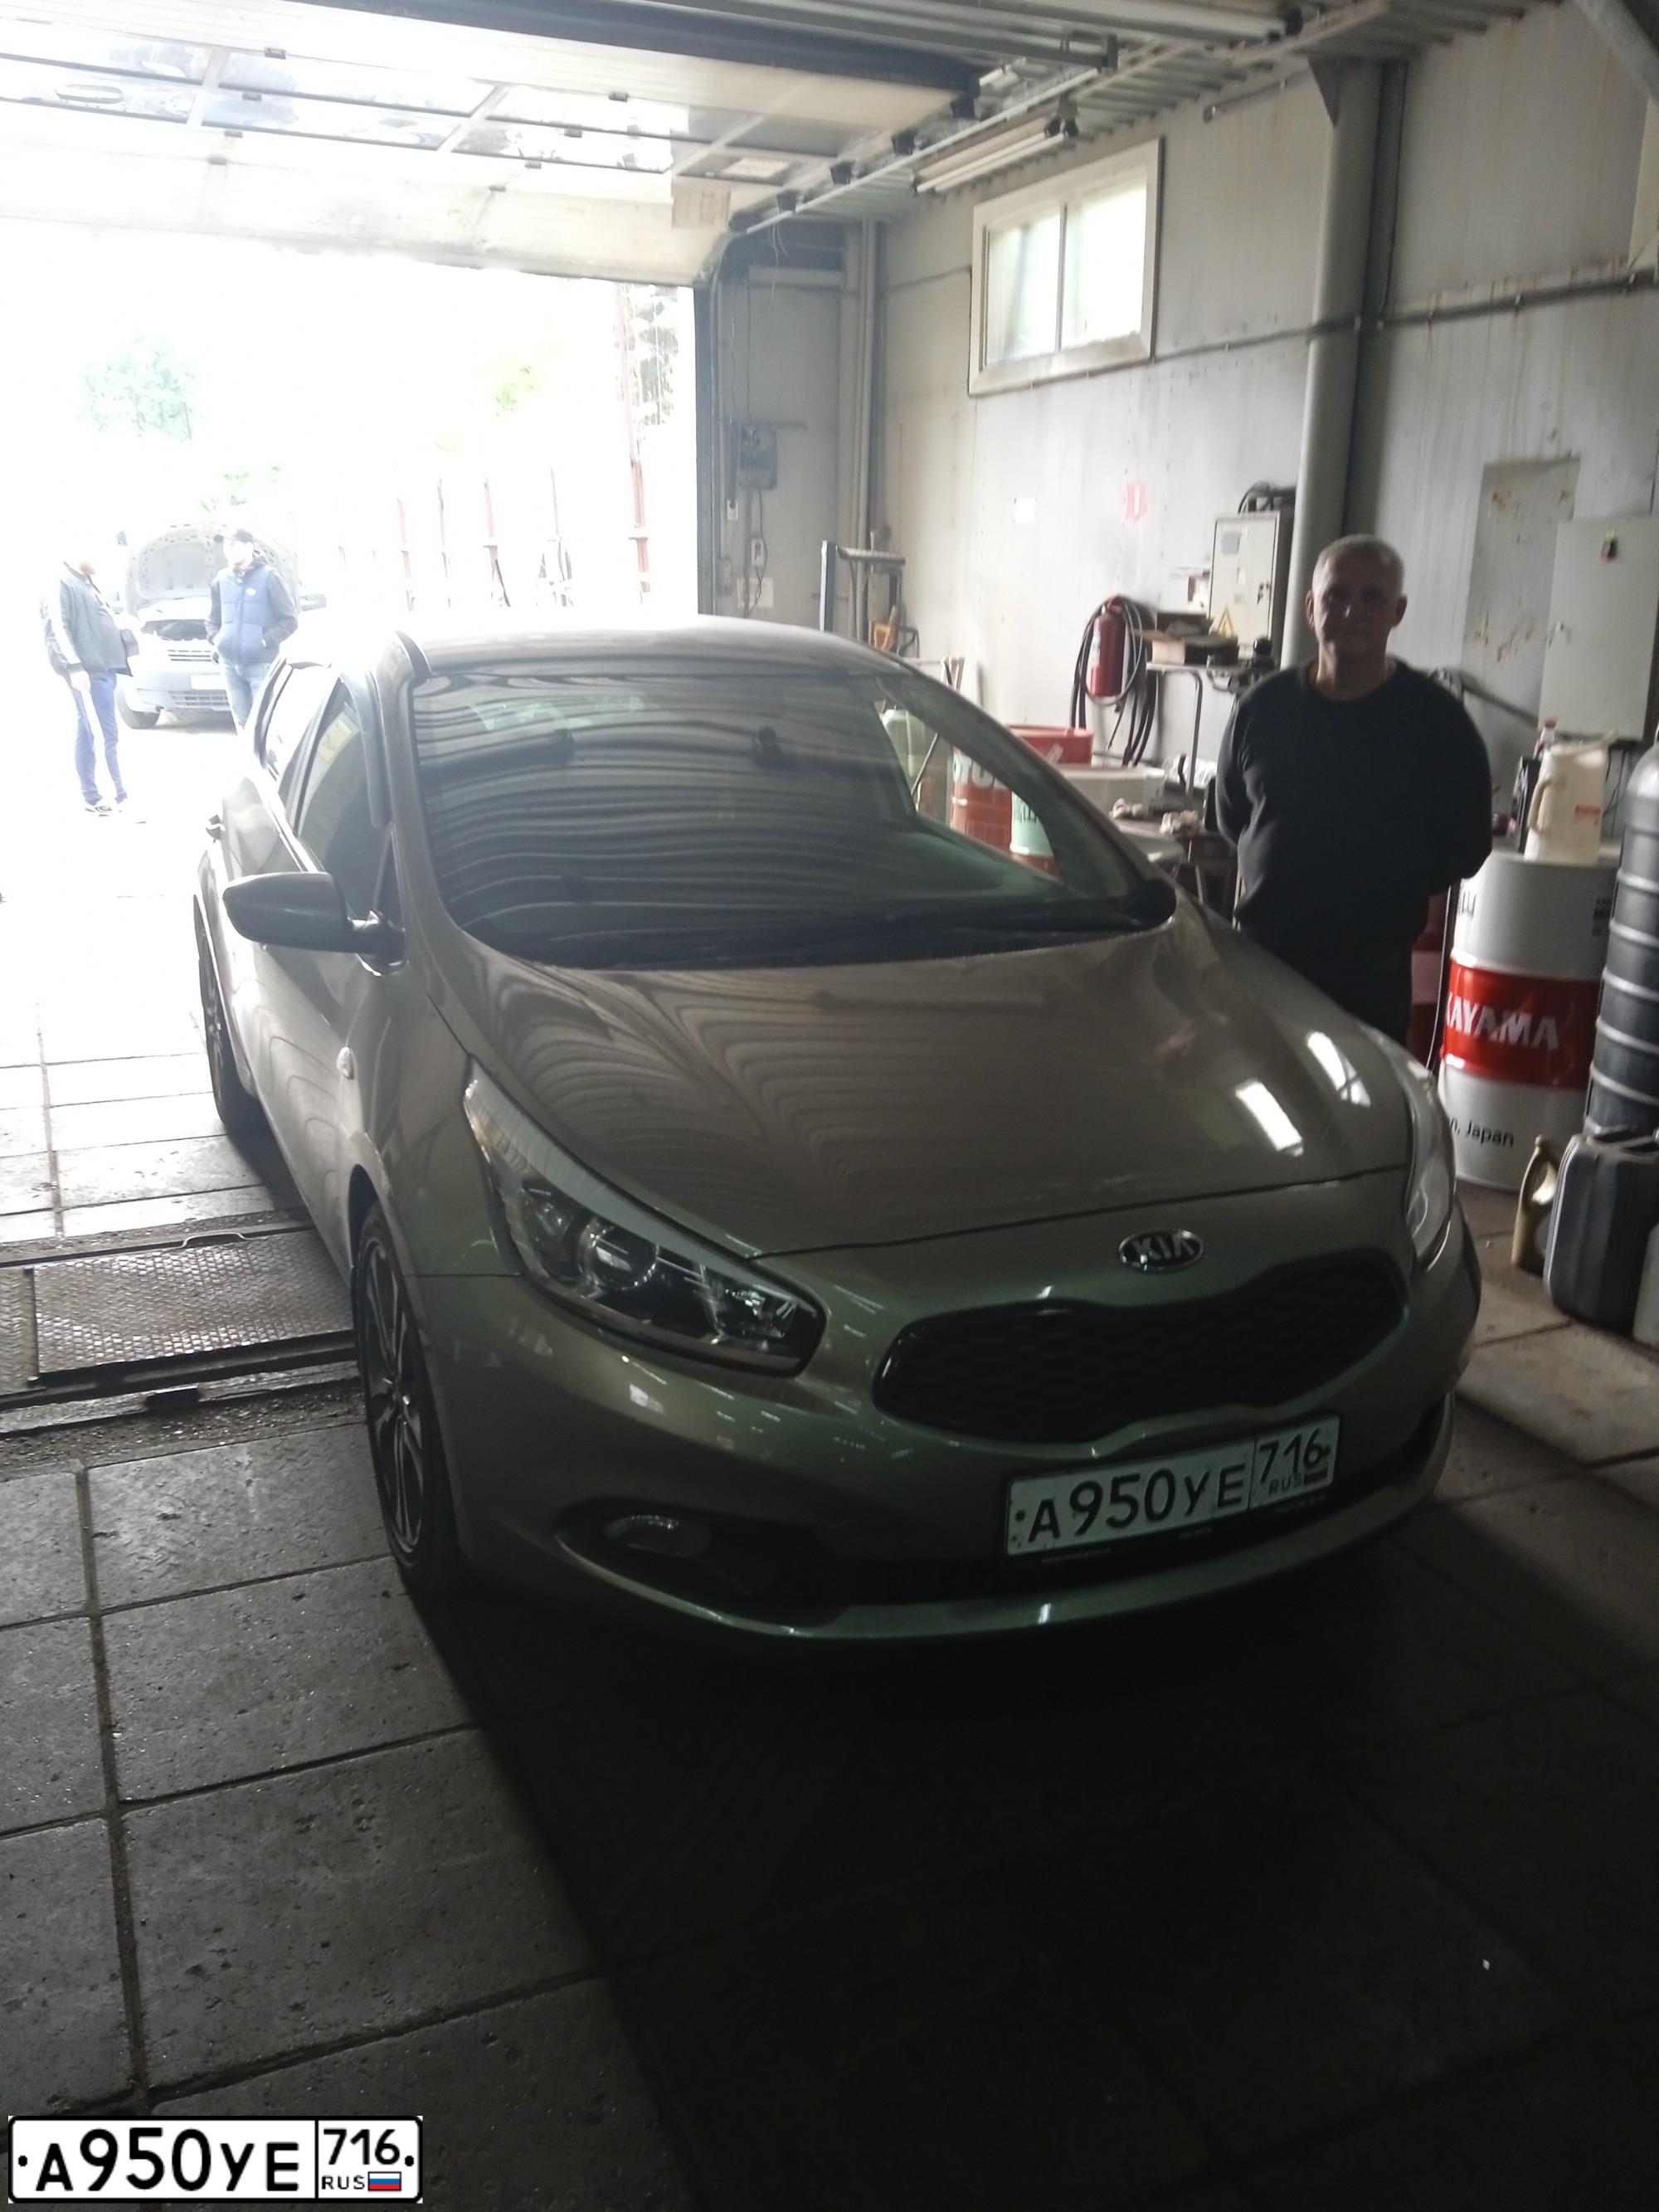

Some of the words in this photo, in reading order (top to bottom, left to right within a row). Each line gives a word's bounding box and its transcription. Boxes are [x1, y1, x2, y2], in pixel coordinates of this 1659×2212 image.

[1466, 1119, 1515, 1147] Japan
[1259, 1426, 1322, 1484] 716
[1028, 1463, 1246, 1542] А950УЕ
[1268, 1471, 1301, 1496] RUS
